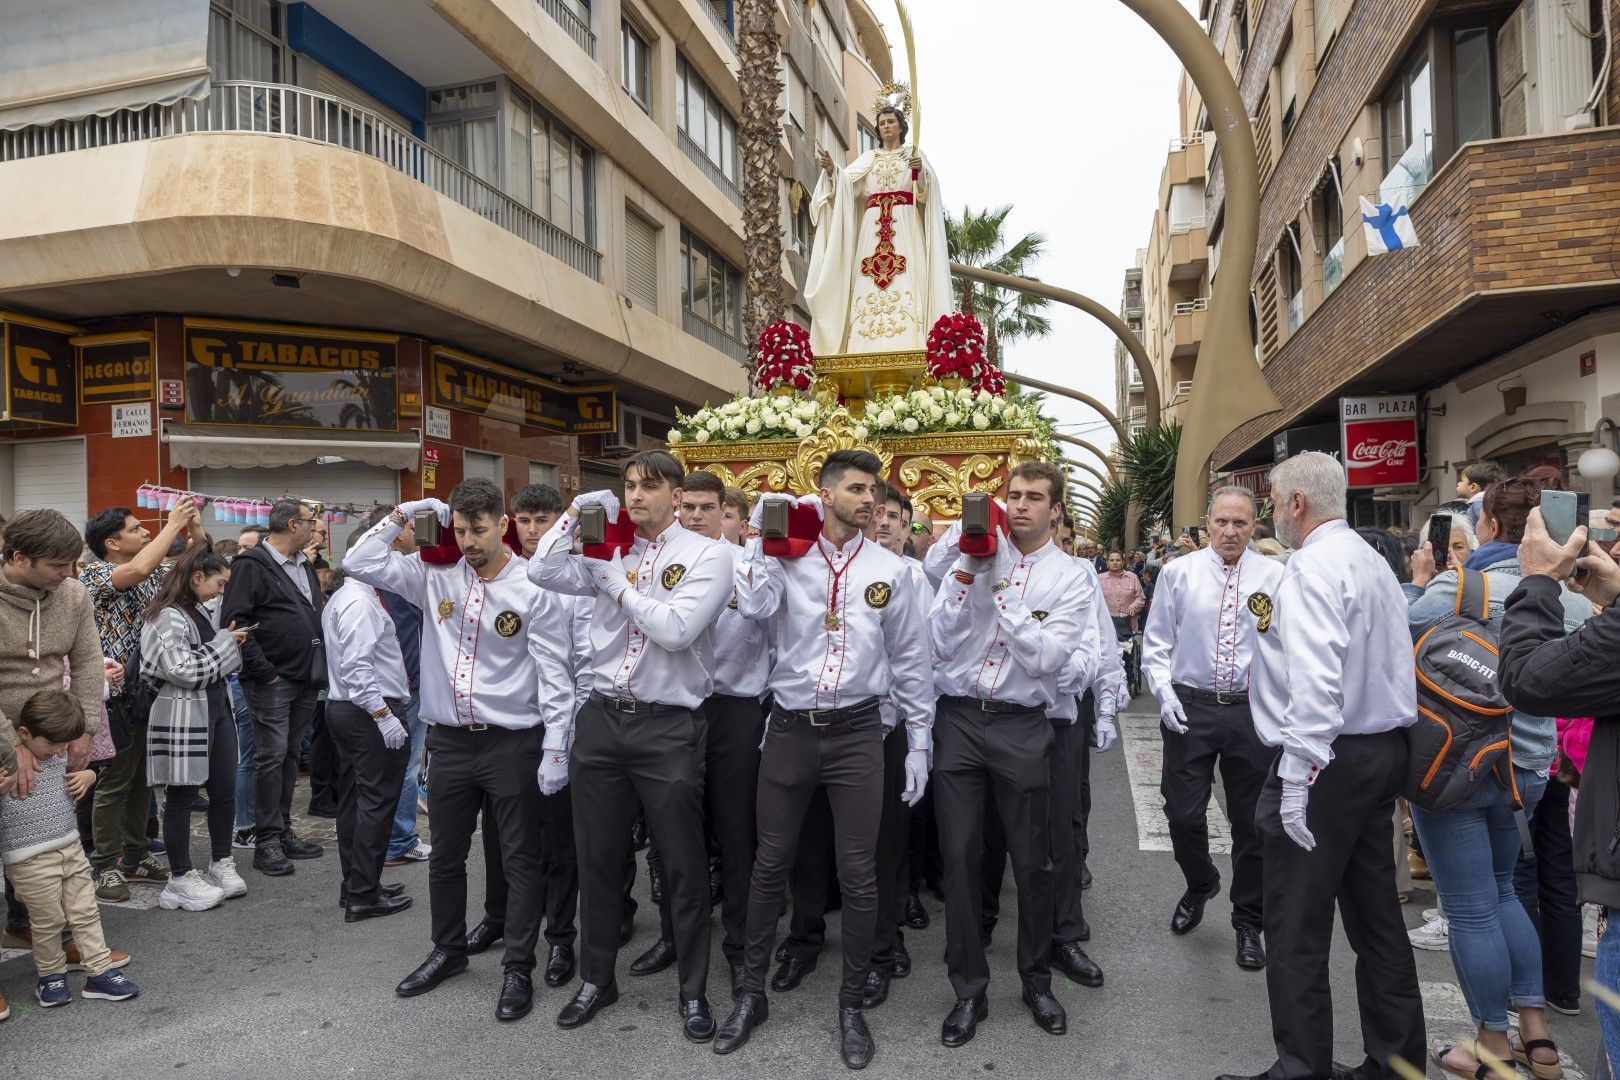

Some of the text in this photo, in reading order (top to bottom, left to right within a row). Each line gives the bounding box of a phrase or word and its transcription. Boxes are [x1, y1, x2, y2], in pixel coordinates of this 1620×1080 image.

[237, 340, 380, 369] TABACOS
[84, 360, 151, 379] REGALOS
[13, 387, 63, 403] TABACOS
[463, 370, 543, 414] TABACOS
[125, 408, 147, 417] CALLE
[1345, 400, 1416, 416] BAR PLAZA
[574, 420, 611, 430] TABACOS
[1352, 440, 1407, 460] Coca-Cola
[1236, 473, 1257, 492] MINI
[1447, 649, 1496, 680] BASIC-FIT
